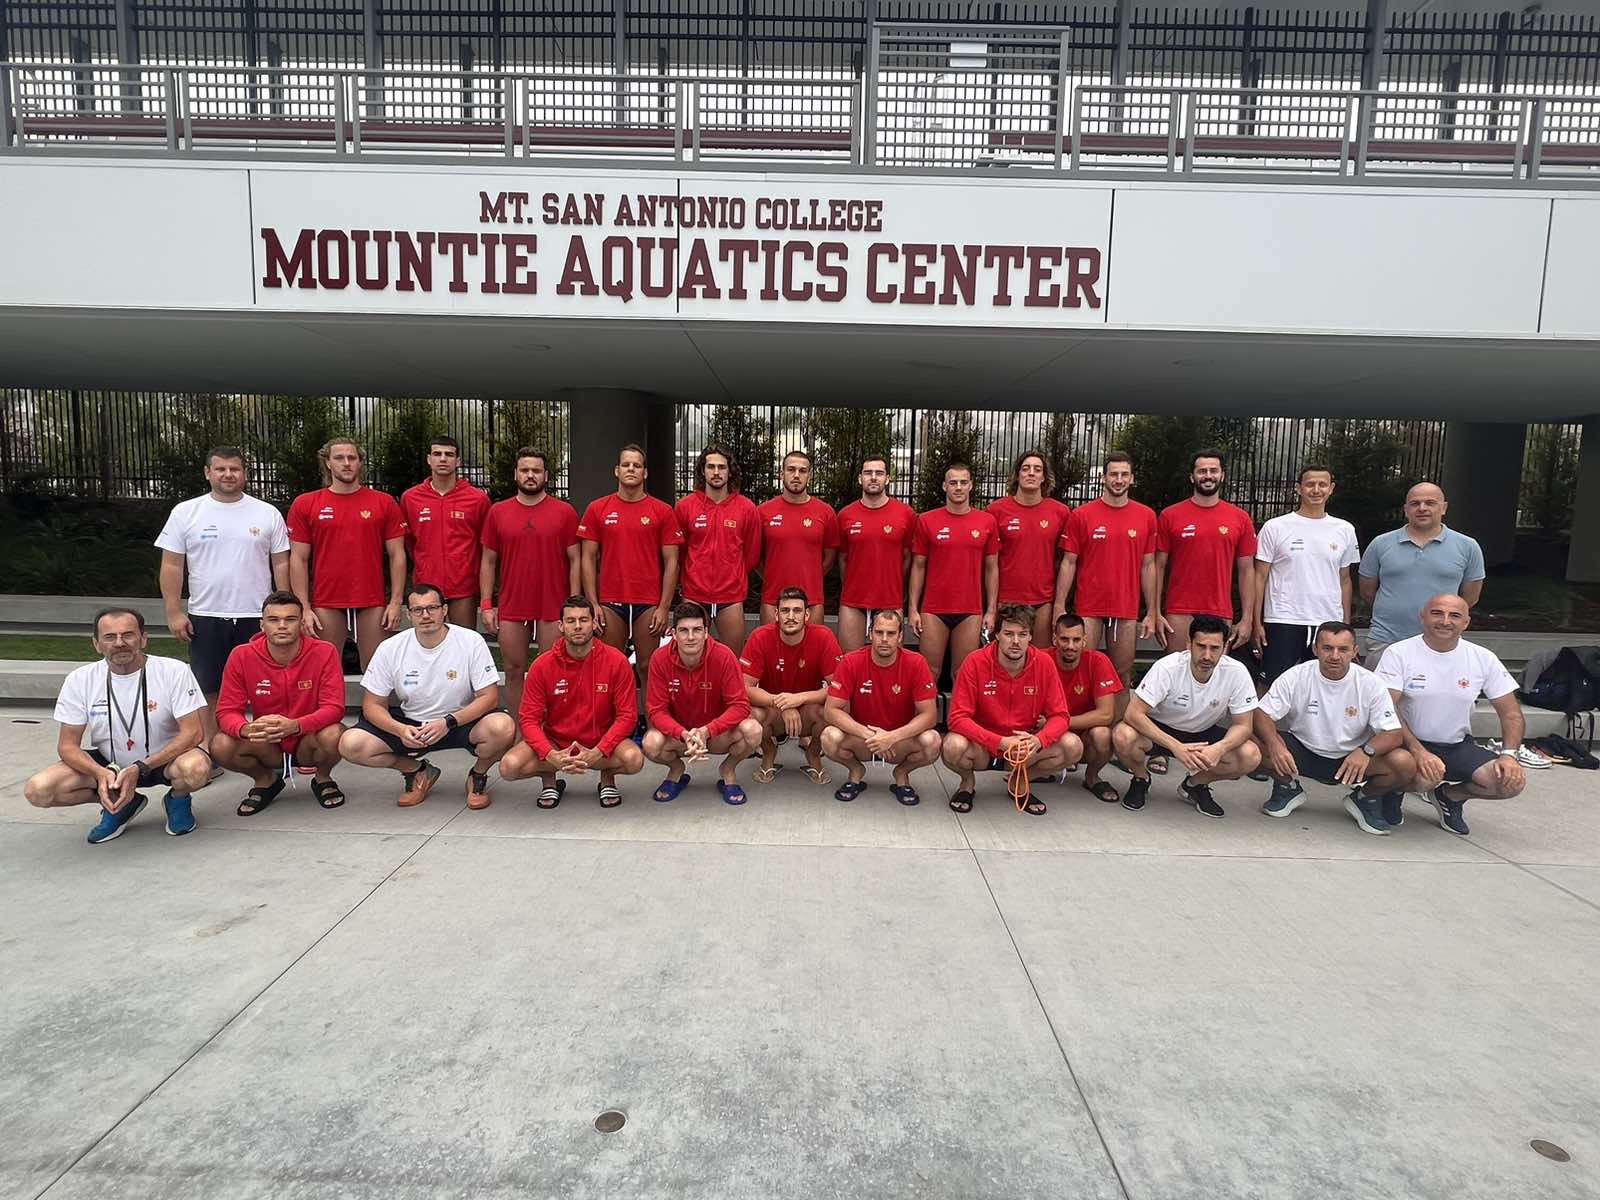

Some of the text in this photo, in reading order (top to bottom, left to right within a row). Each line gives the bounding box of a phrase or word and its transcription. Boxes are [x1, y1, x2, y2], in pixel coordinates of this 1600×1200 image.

[479, 191, 883, 232] MT. SAN ANTONIO COLLEGE
[260, 227, 1102, 309] MOUNTIE AQUATICS CENTER
